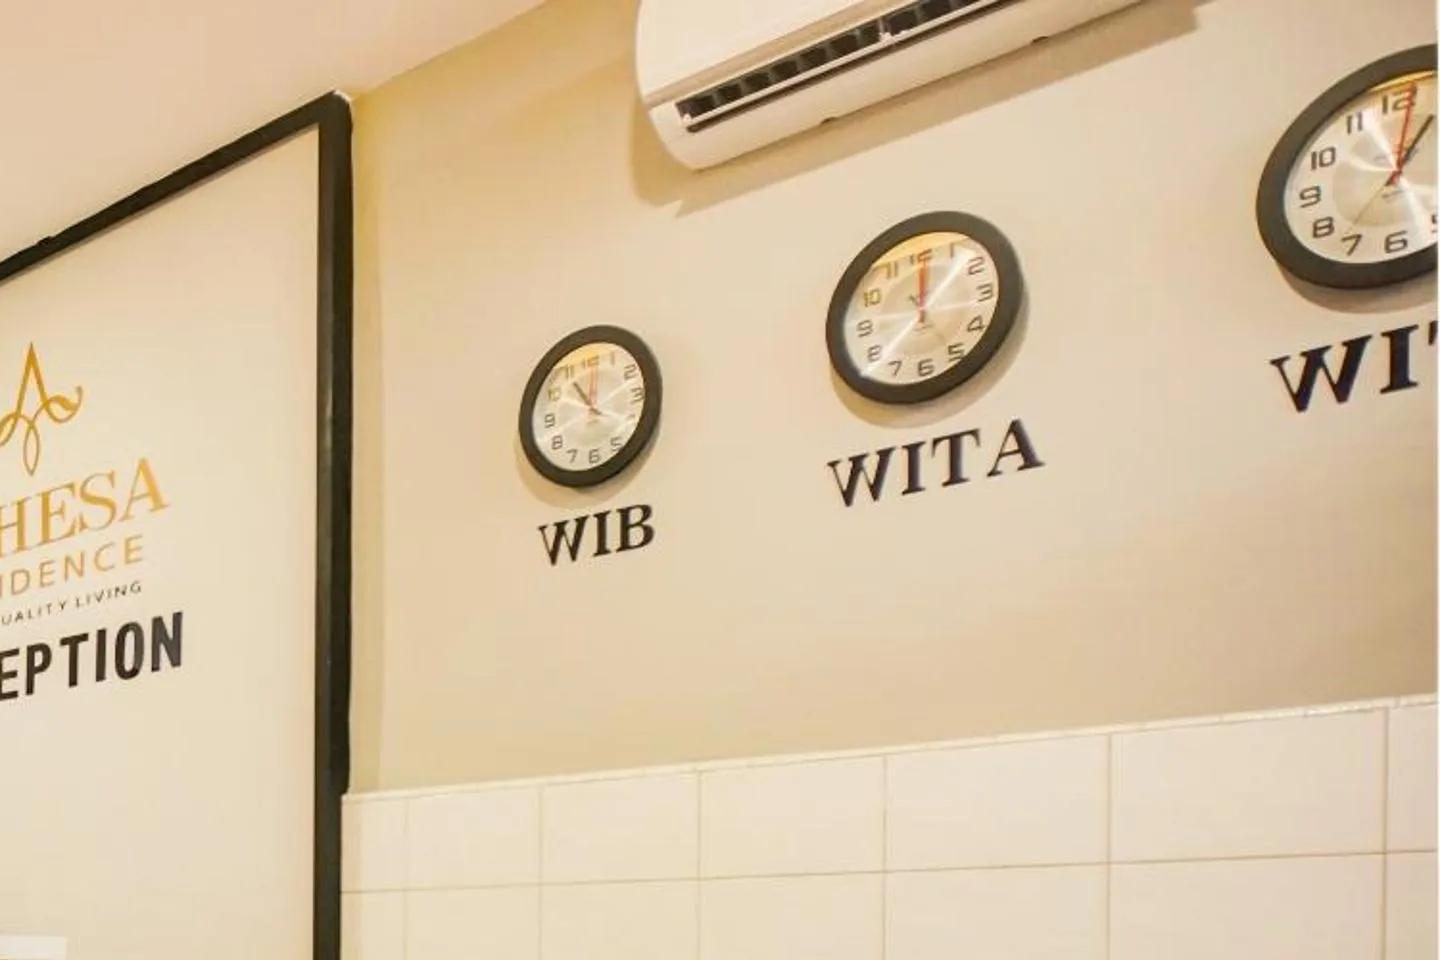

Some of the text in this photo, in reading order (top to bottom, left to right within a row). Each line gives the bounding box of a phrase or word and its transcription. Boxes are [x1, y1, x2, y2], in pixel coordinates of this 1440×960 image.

[1382, 89, 1416, 115] 12
[1346, 112, 1363, 134] 11
[1310, 147, 1336, 171] 10
[1298, 185, 1322, 209] 9
[1312, 216, 1335, 239] 8
[1341, 234, 1363, 256] 7
[1384, 230, 1409, 254] 6
[968, 256, 984, 276] 2
[863, 288, 881, 307] 10
[976, 283, 994, 302] 3
[856, 319, 874, 338] 9
[966, 315, 986, 333] 4
[867, 344, 882, 363] 8
[947, 342, 965, 362] 5
[888, 360, 902, 377] 7
[917, 358, 935, 377] 6
[1270, 320, 1438, 413] WI
[544, 412, 556, 429] 9
[551, 435, 564, 450] 8
[566, 448, 579, 463] 7
[588, 448, 602, 465] 6
[827, 417, 1046, 508] WITA
[537, 503, 656, 567] WIB
[75, 579, 143, 608] LIVING
